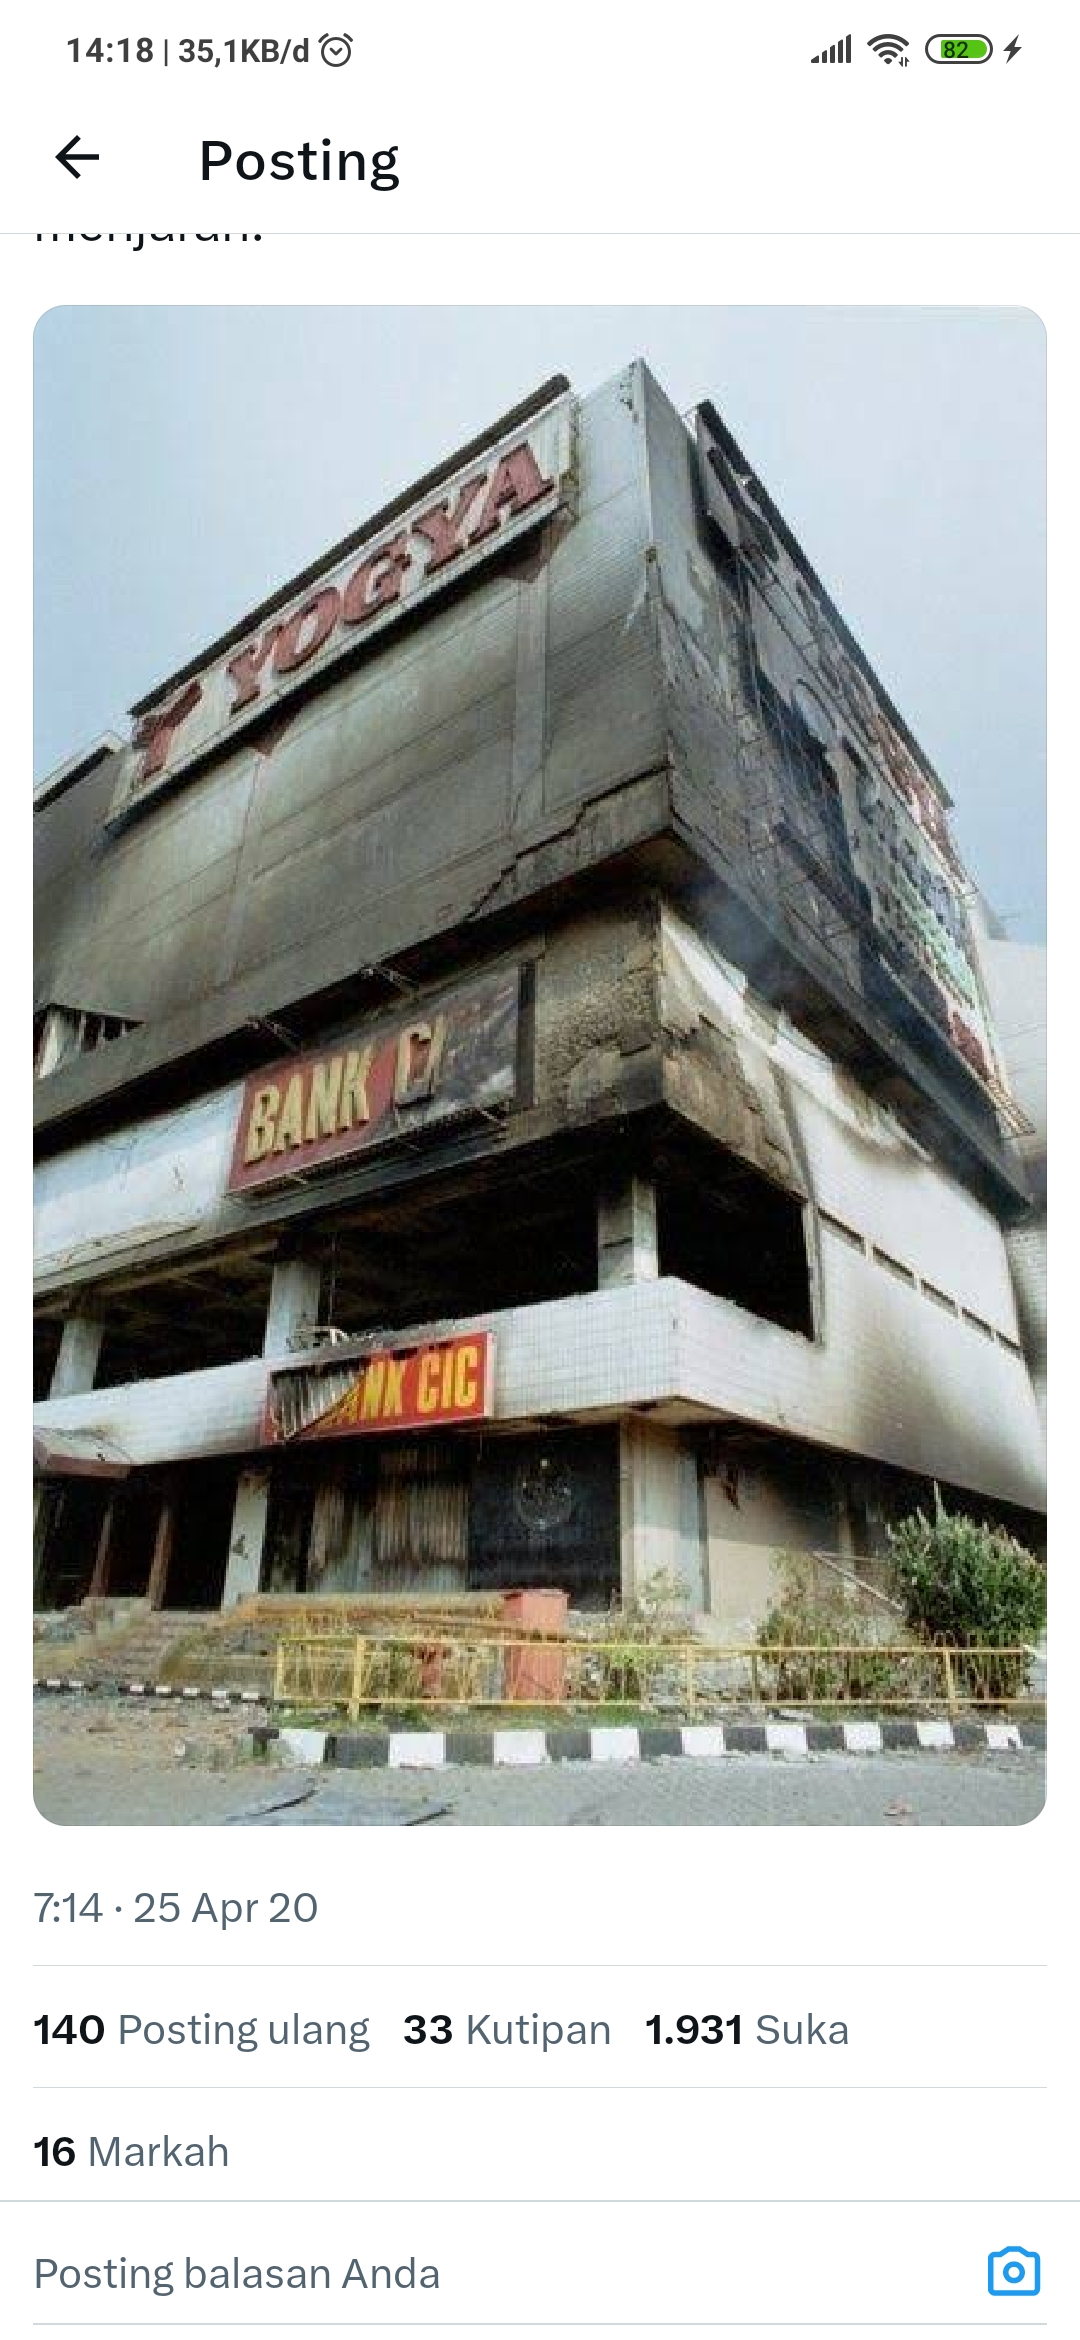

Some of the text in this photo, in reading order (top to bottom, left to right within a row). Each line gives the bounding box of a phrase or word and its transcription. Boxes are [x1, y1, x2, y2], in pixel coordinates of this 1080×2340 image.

[68, 37, 309, 68] 14:18 35,1KB/d
[943, 41, 969, 59] 82
[202, 138, 399, 191] Posting
[225, 442, 554, 715] YOGYA
[245, 1046, 372, 1167] BANK
[417, 1346, 478, 1414] CIC
[34, 1893, 317, 1930] 7:14 25 Apr 20
[34, 2013, 848, 2052] 140 Posting ulang 33 Kutipan 1.931 Suka
[34, 2135, 228, 2167] 16 Markah
[35, 2257, 440, 2296] Posting balasan Anda
